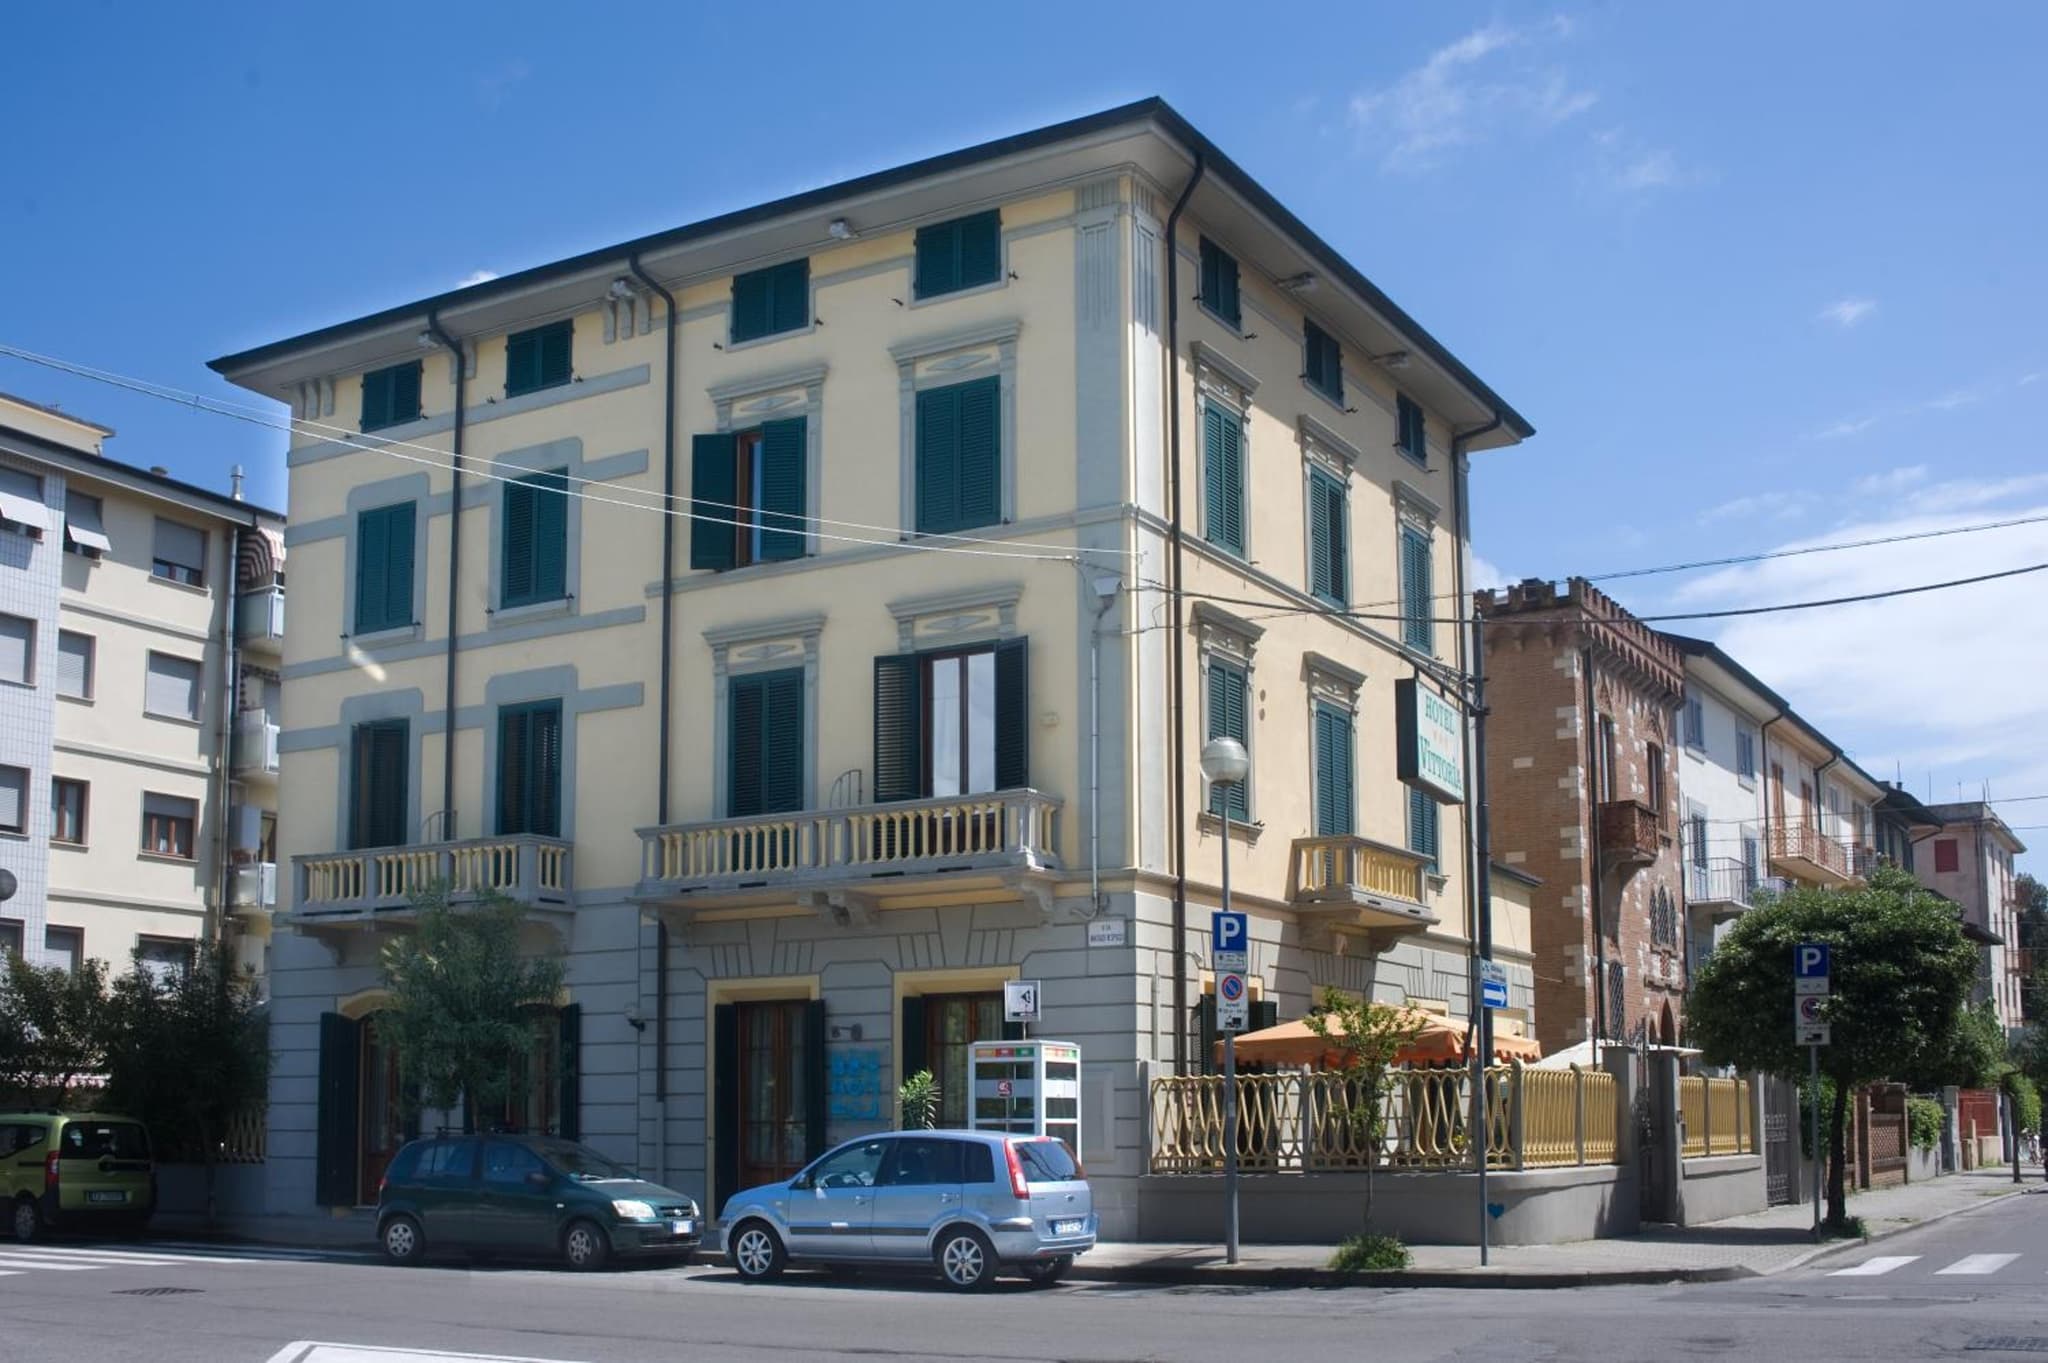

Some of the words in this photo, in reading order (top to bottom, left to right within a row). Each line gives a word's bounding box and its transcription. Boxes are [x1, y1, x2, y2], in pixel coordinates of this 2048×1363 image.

[1425, 695, 1455, 735] HOTEL
[1219, 917, 1240, 948] P
[1801, 947, 1822, 975] P
